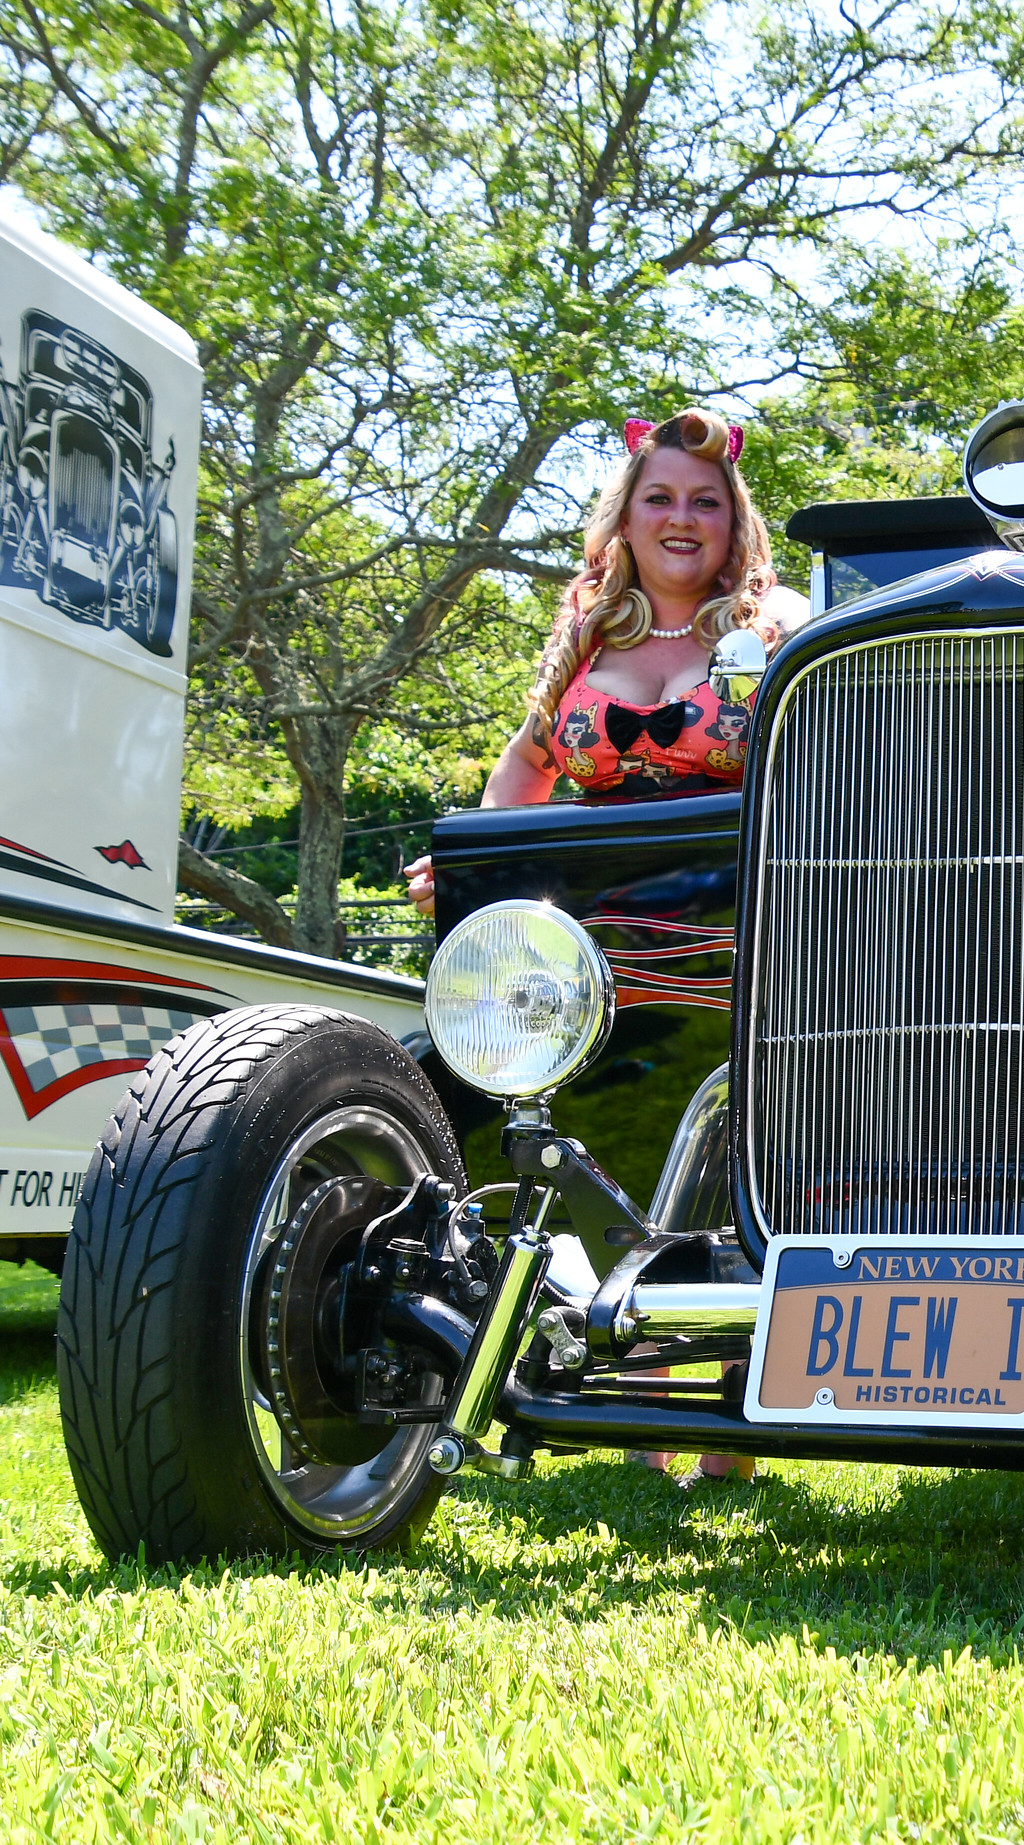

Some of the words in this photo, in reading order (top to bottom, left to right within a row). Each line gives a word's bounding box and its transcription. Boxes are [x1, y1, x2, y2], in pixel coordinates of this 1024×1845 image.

[10, 1170, 53, 1207] FOR
[857, 1255, 940, 1280] NEW
[806, 1295, 958, 1379] BLEW
[856, 1385, 1006, 1406] HISTORICAL
